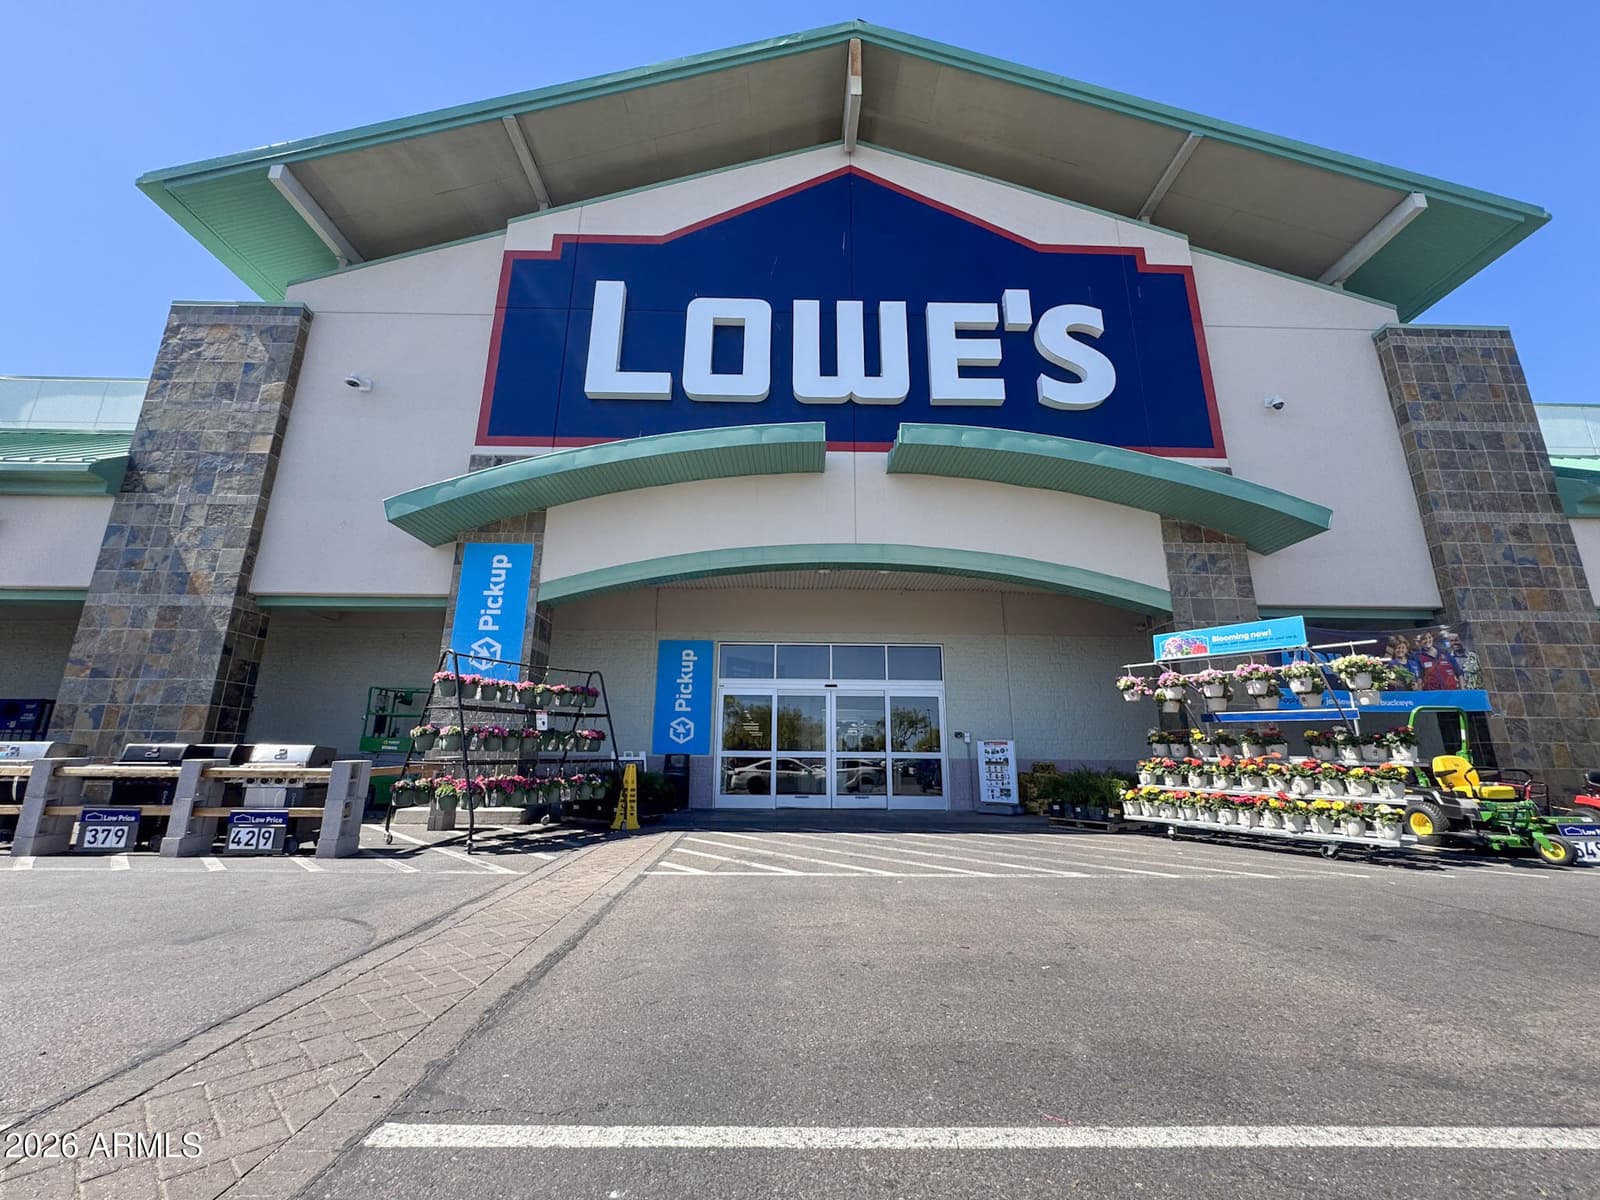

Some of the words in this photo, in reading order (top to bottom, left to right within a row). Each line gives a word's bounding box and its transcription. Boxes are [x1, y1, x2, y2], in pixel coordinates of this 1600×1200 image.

[585, 280, 1117, 411] LOWE'S
[478, 554, 512, 631] Pickup
[1211, 632, 1250, 643] Blooming
[1250, 628, 1272, 638] now!
[674, 649, 698, 712] Pickup
[118, 814, 136, 822] Price
[251, 815, 266, 823] Low
[266, 815, 284, 823] Price
[86, 828, 126, 845] 379
[231, 830, 272, 847] 429
